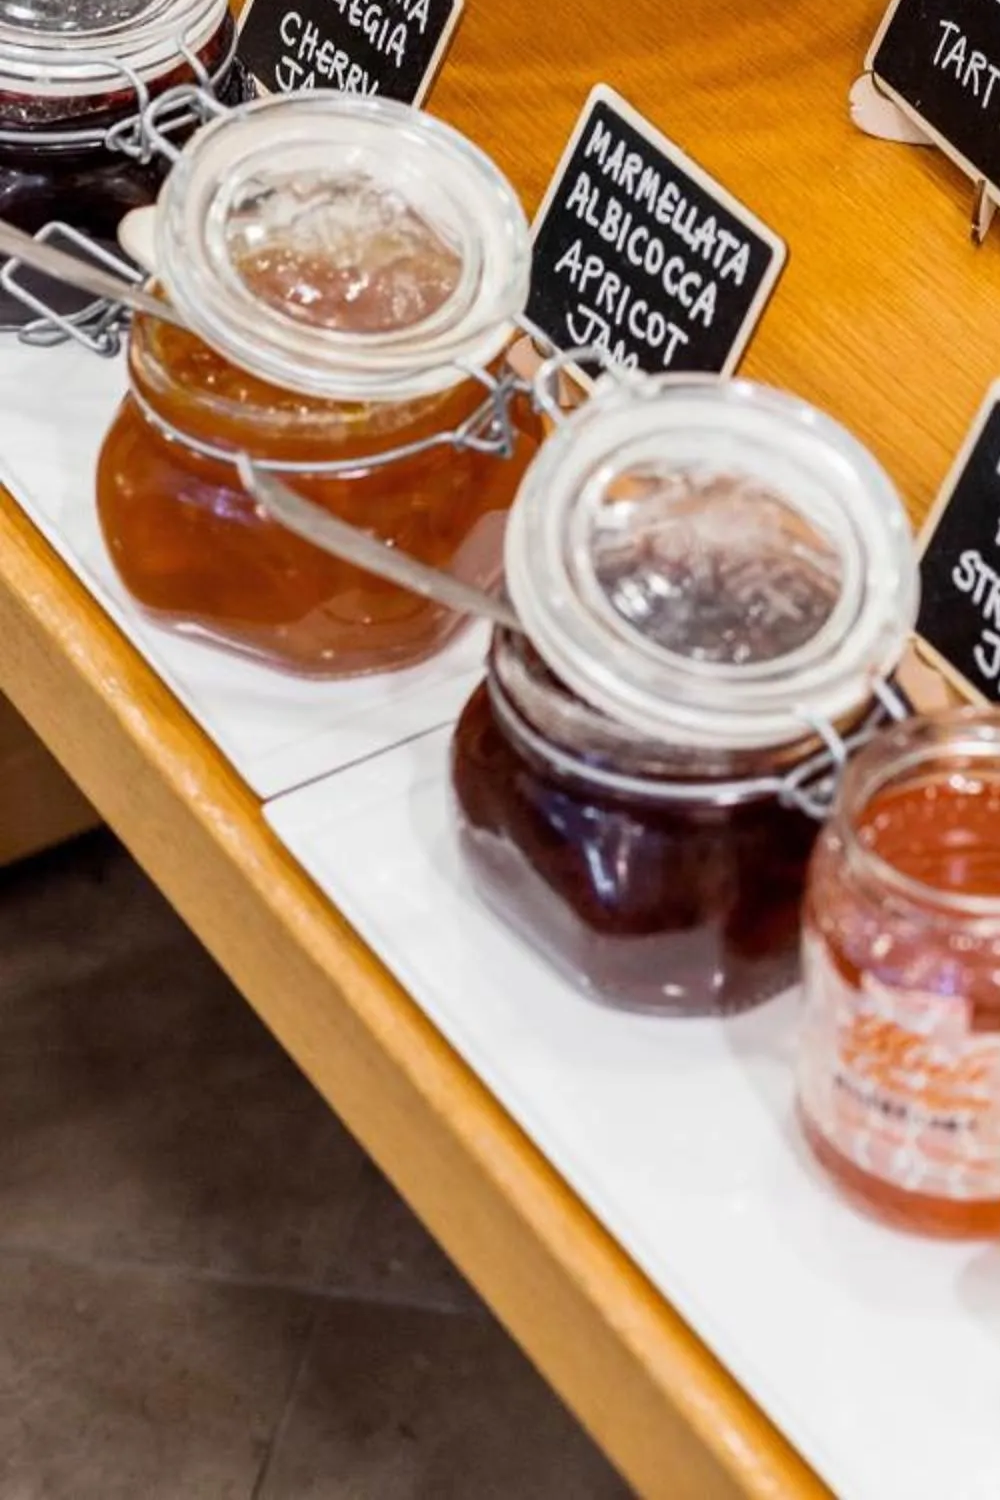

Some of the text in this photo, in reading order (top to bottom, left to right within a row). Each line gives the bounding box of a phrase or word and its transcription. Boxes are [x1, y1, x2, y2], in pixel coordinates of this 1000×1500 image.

[275, 55, 315, 93] JA
[565, 171, 718, 328] ALBICOCCA
[584, 119, 750, 286] MARMELLATA
[554, 239, 689, 366] APRICOT
